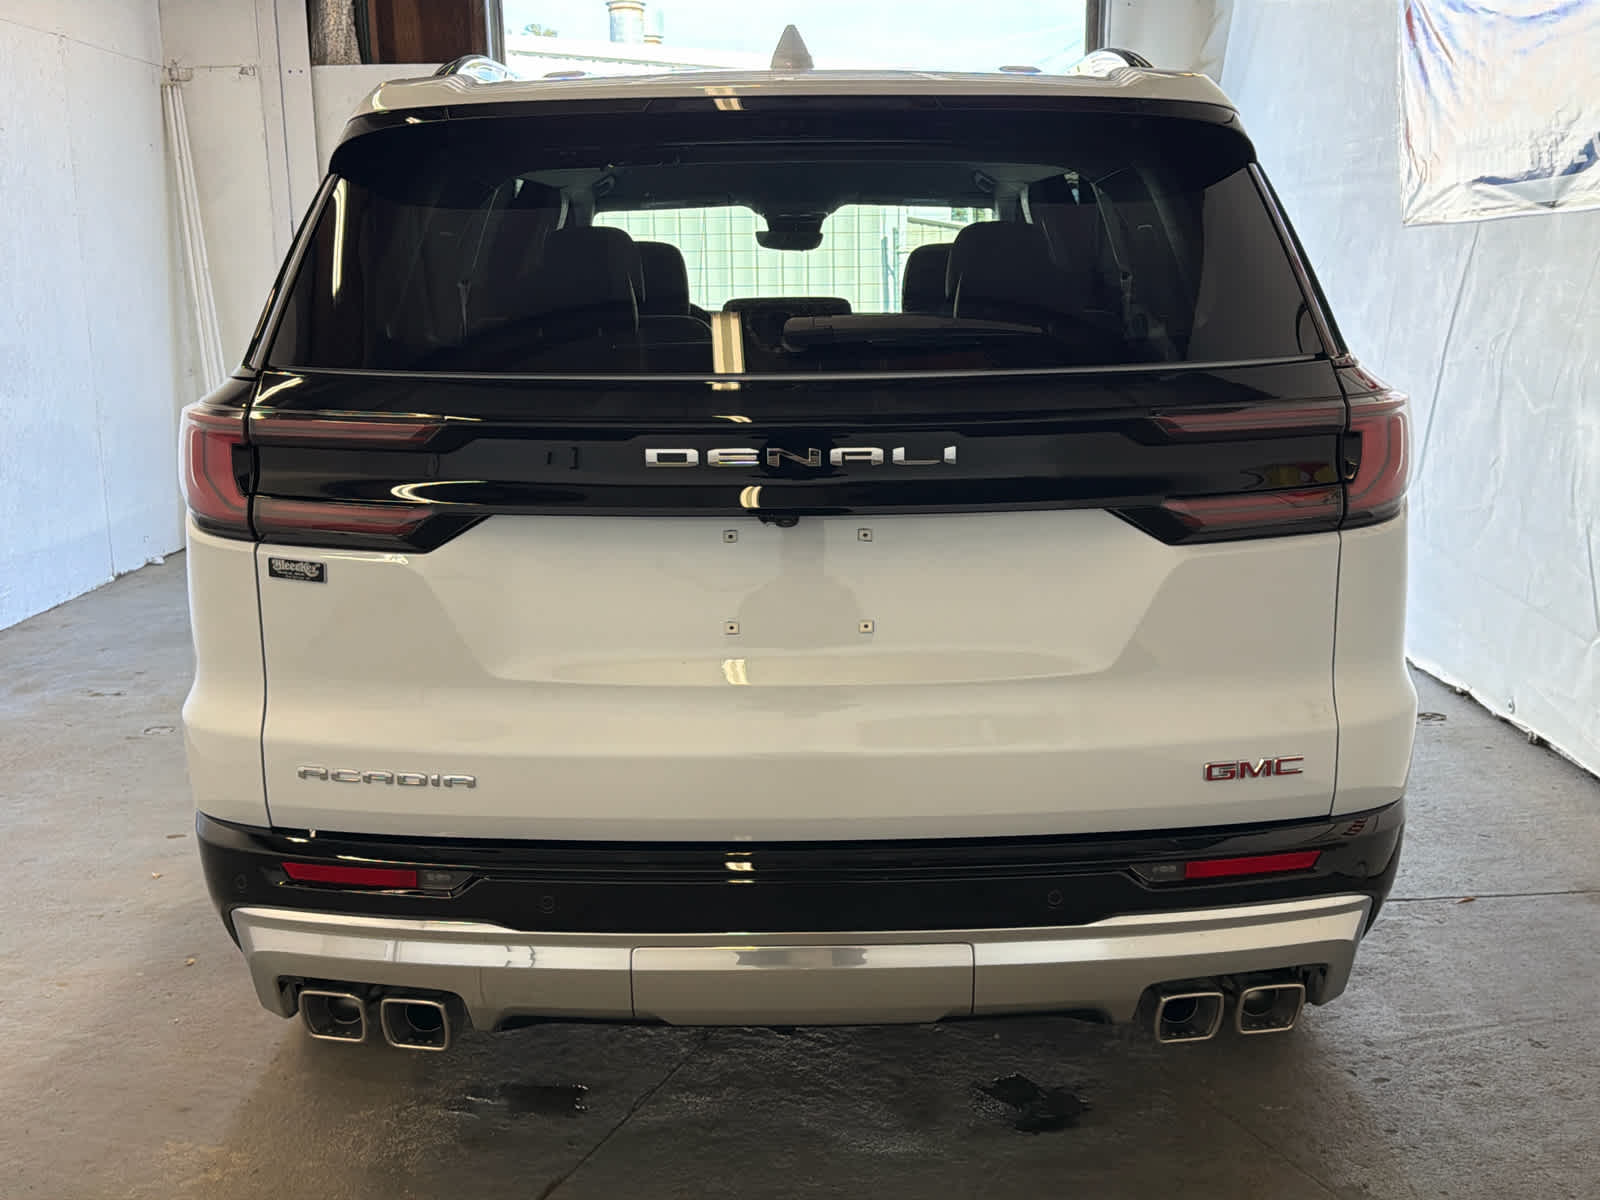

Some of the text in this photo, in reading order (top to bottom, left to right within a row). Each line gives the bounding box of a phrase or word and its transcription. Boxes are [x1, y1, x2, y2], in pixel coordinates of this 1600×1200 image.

[645, 446, 957, 468] DENALI
[297, 766, 477, 788] ACADIA
[1203, 756, 1305, 781] GMC
